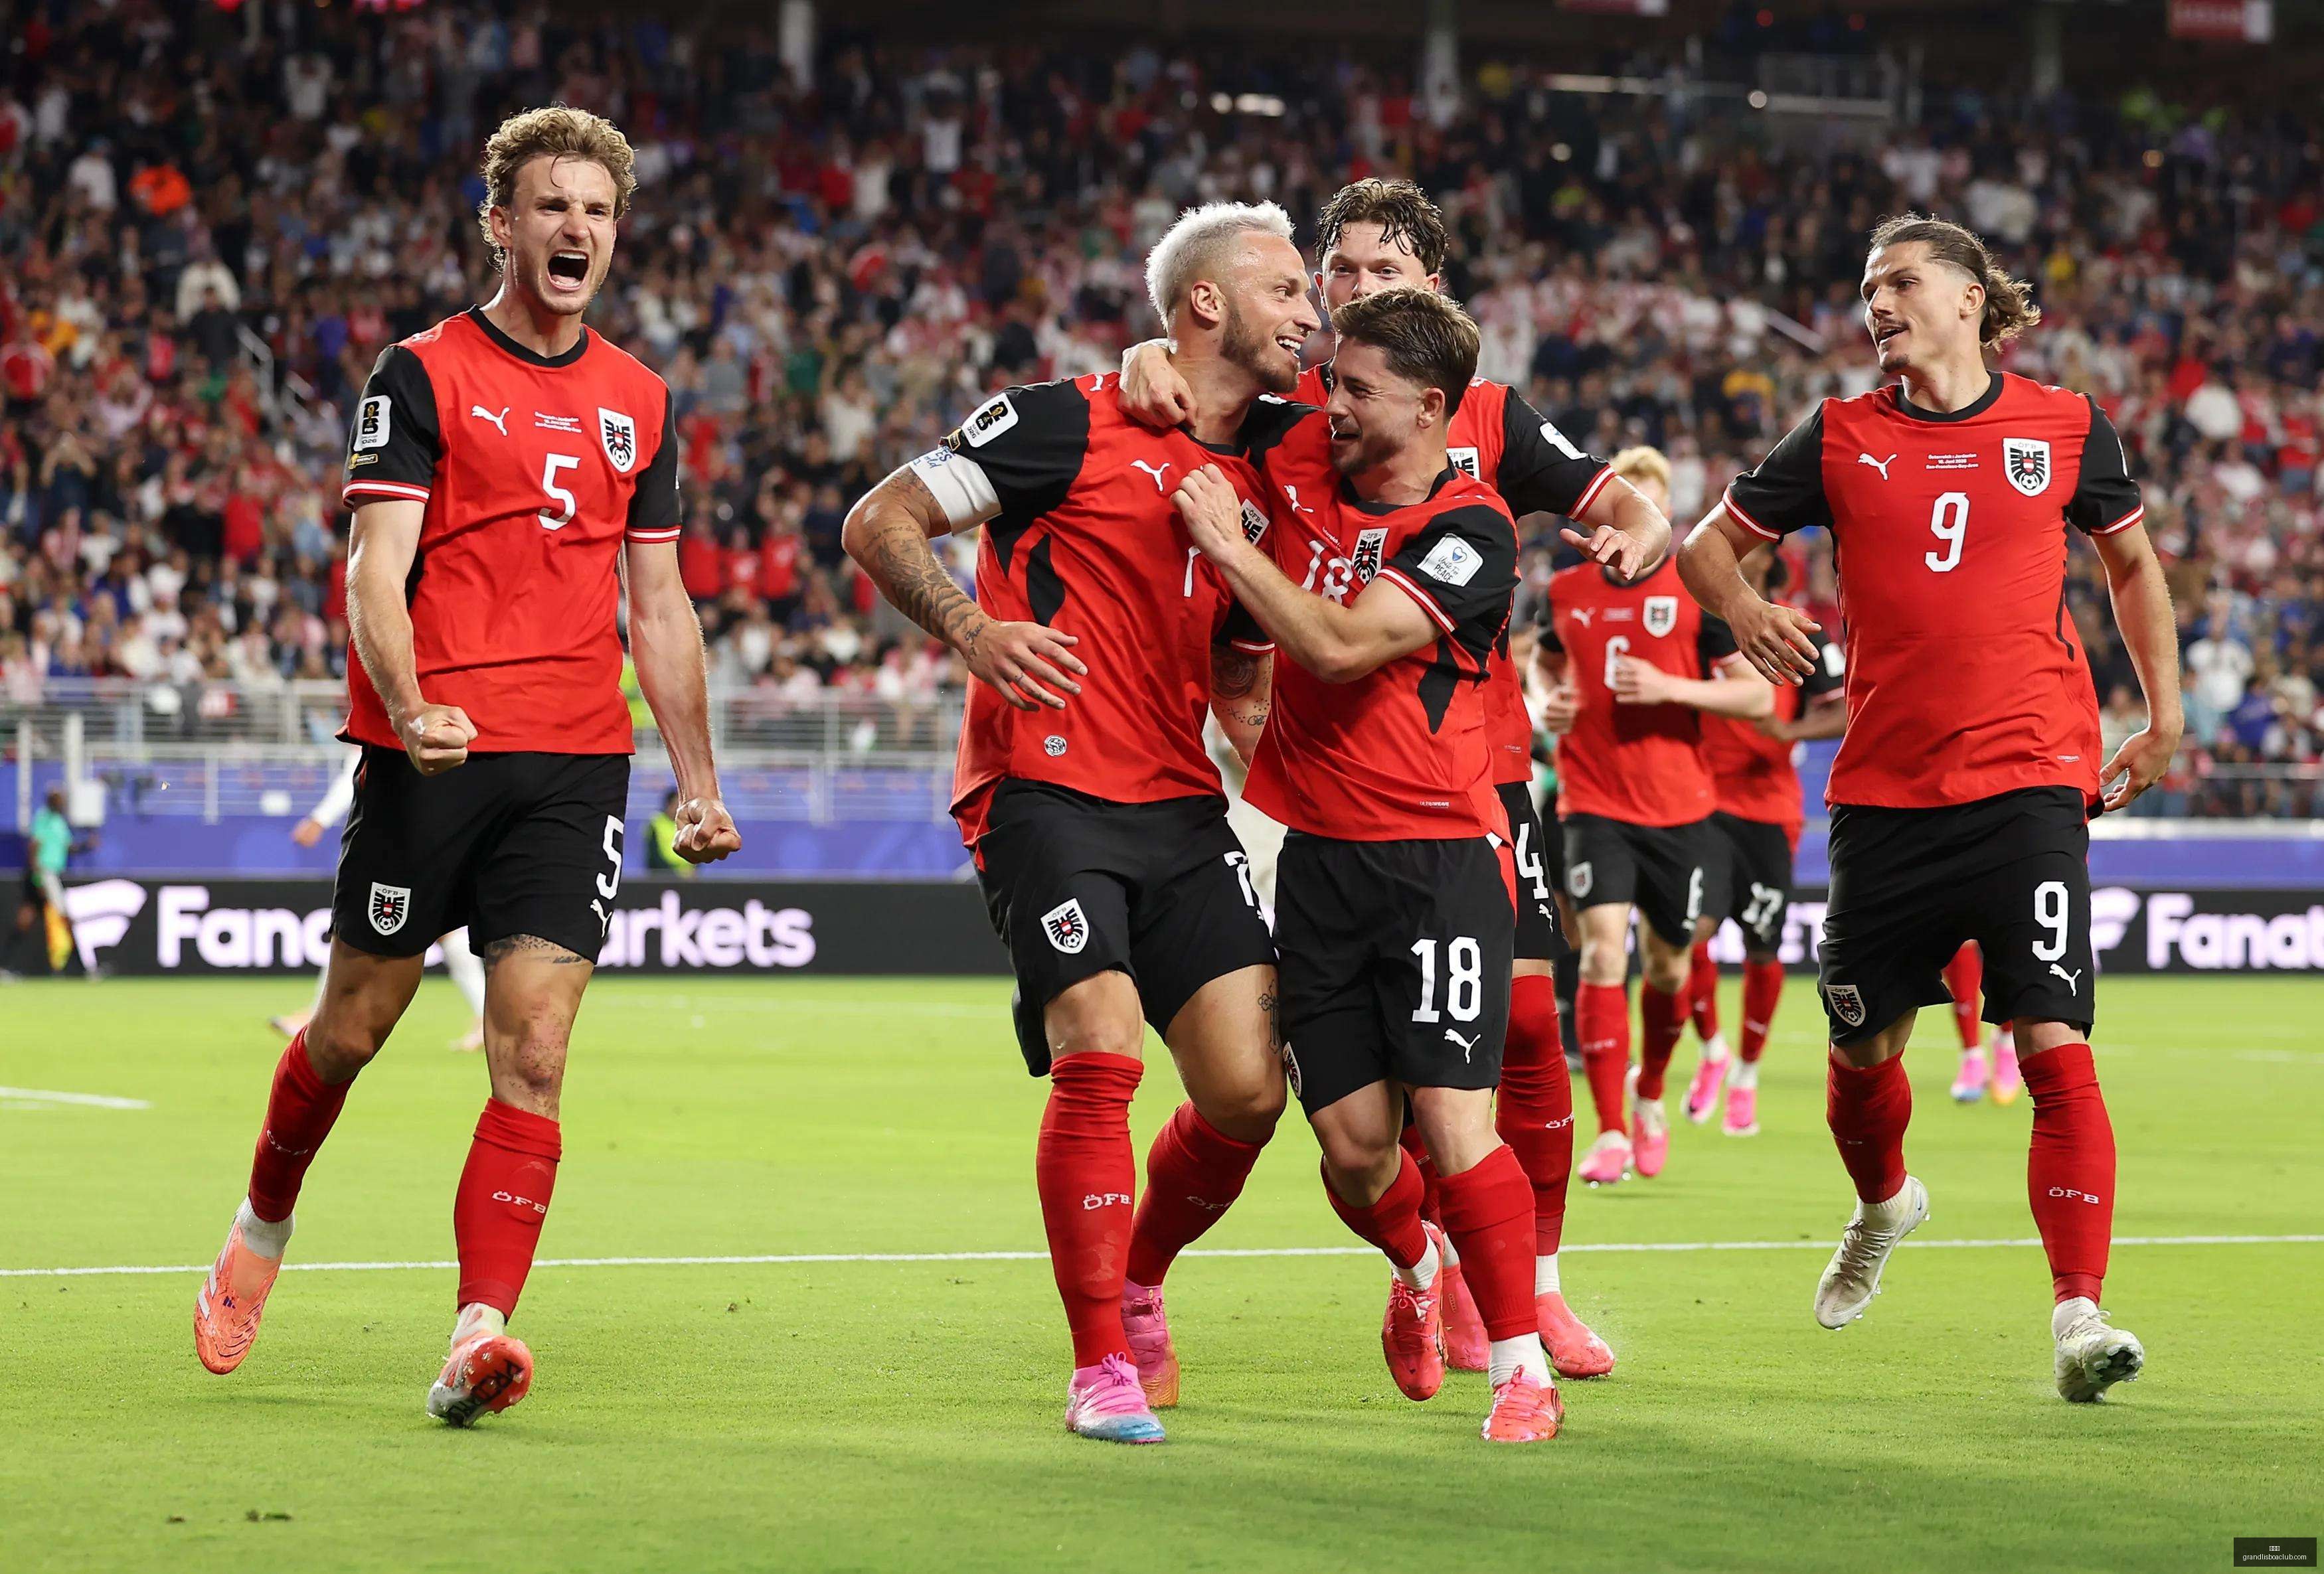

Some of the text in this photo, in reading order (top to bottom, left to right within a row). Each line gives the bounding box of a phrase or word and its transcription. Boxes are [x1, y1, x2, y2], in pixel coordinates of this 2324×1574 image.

[539, 453, 581, 530] 5
[1248, 509, 1262, 523] ÖFB
[1925, 492, 1970, 572] 9
[1301, 540, 1353, 606] 18
[1434, 564, 1453, 581] PEACE
[596, 815, 625, 900] 5
[1515, 823, 1549, 900] 4
[2033, 880, 2070, 962] 9
[1410, 936, 1483, 1022] 18
[491, 1190, 546, 1214] ÖFB
[1082, 1193, 1132, 1211] ÖFB
[2048, 1187, 2100, 1204] ÖFB
